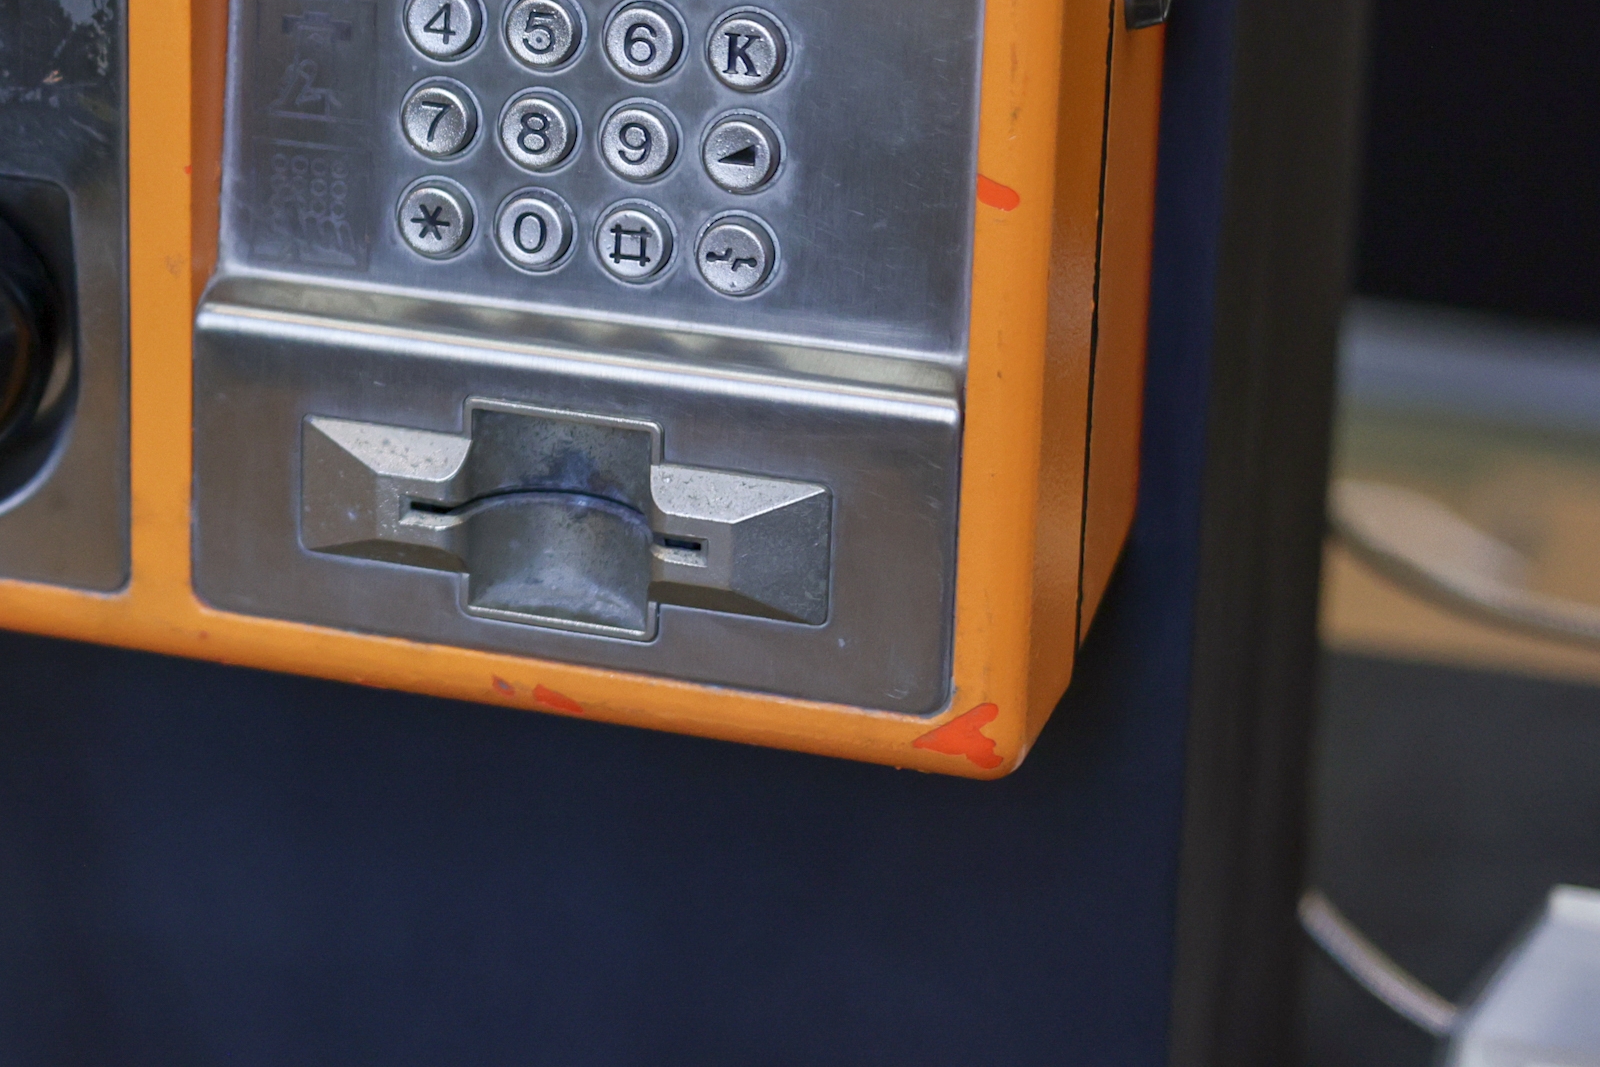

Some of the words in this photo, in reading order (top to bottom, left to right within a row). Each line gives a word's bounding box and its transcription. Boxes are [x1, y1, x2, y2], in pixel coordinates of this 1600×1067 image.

[423, 3, 455, 45] 4
[524, 12, 556, 55] 5
[625, 24, 657, 66] 6
[722, 33, 761, 77] K
[421, 101, 451, 143] 7
[518, 112, 551, 154] 8
[618, 122, 650, 164] 9
